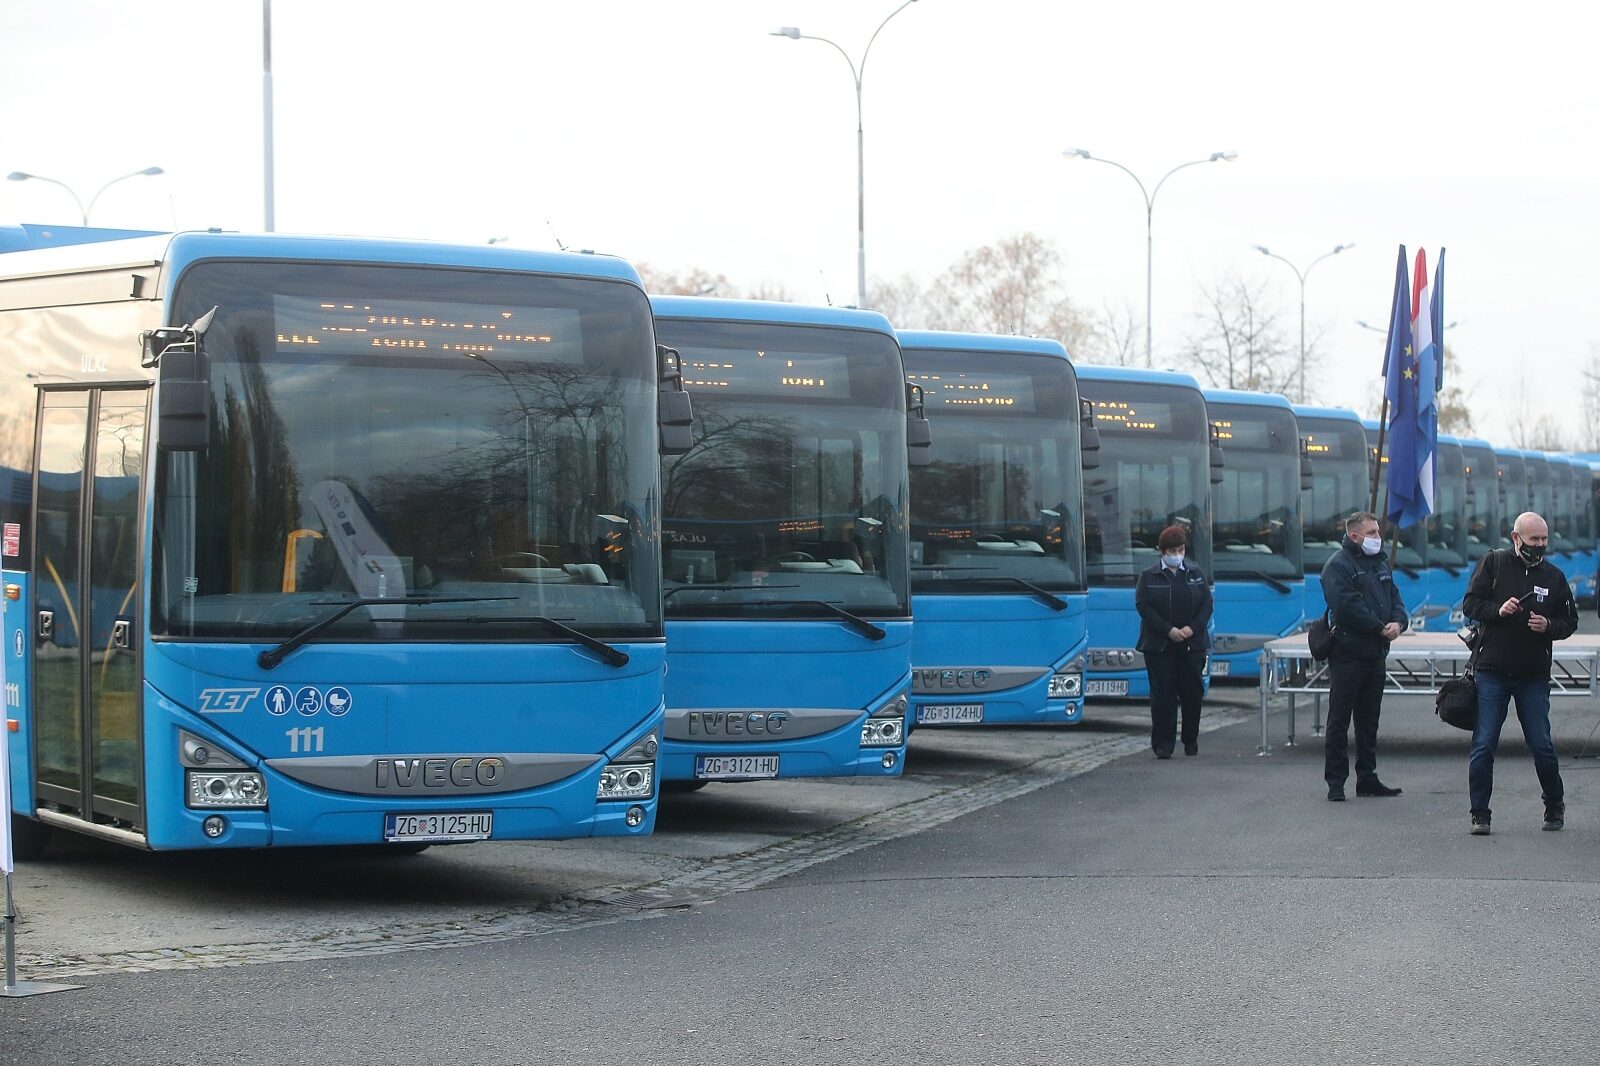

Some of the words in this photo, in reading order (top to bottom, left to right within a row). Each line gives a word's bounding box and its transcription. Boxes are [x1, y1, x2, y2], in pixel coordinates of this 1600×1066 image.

[1087, 650, 1135, 667] ECO
[199, 687, 262, 713] ZET
[688, 711, 789, 735] IVECO
[285, 726, 325, 752] 111
[375, 758, 505, 788] IVECO
[705, 758, 721, 773] ZG
[397, 817, 417, 835] ZG
